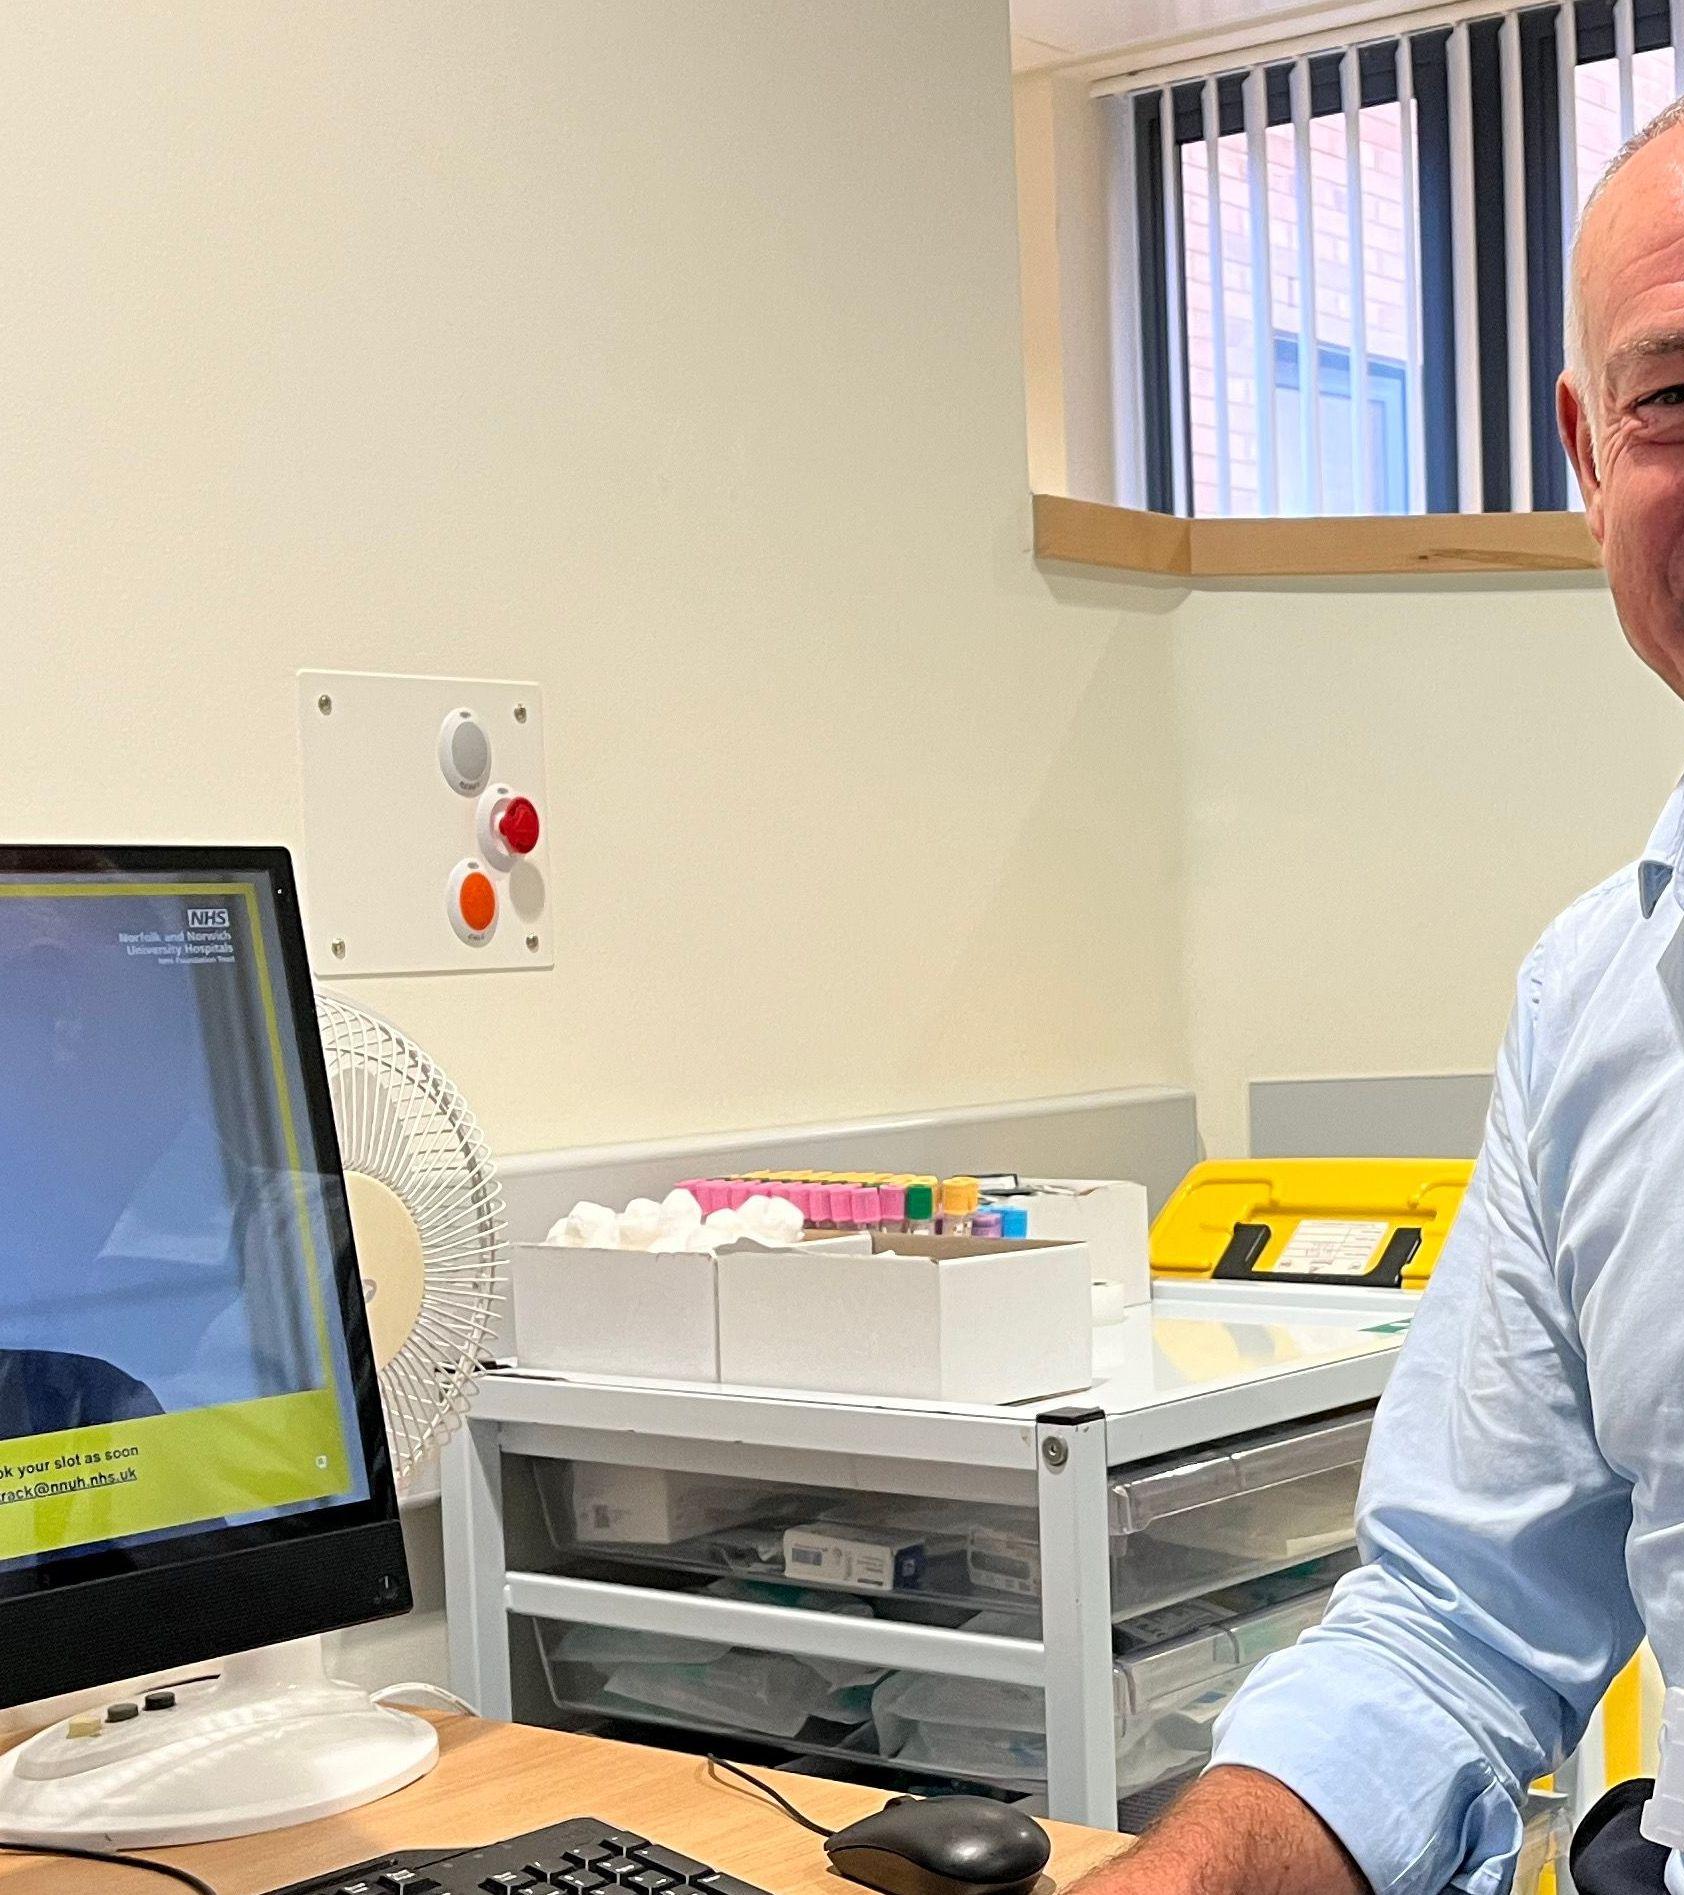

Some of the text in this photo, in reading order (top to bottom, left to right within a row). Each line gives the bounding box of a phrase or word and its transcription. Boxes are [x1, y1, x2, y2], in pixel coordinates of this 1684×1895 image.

[190, 911, 226, 925] NHS
[165, 930, 184, 941] and
[186, 930, 231, 941] Norwich
[126, 943, 233, 956] University Hospitals
[17, 1461, 49, 1478] your
[54, 1454, 81, 1470] slot
[85, 1453, 101, 1464] as
[105, 1447, 139, 1460] soon
